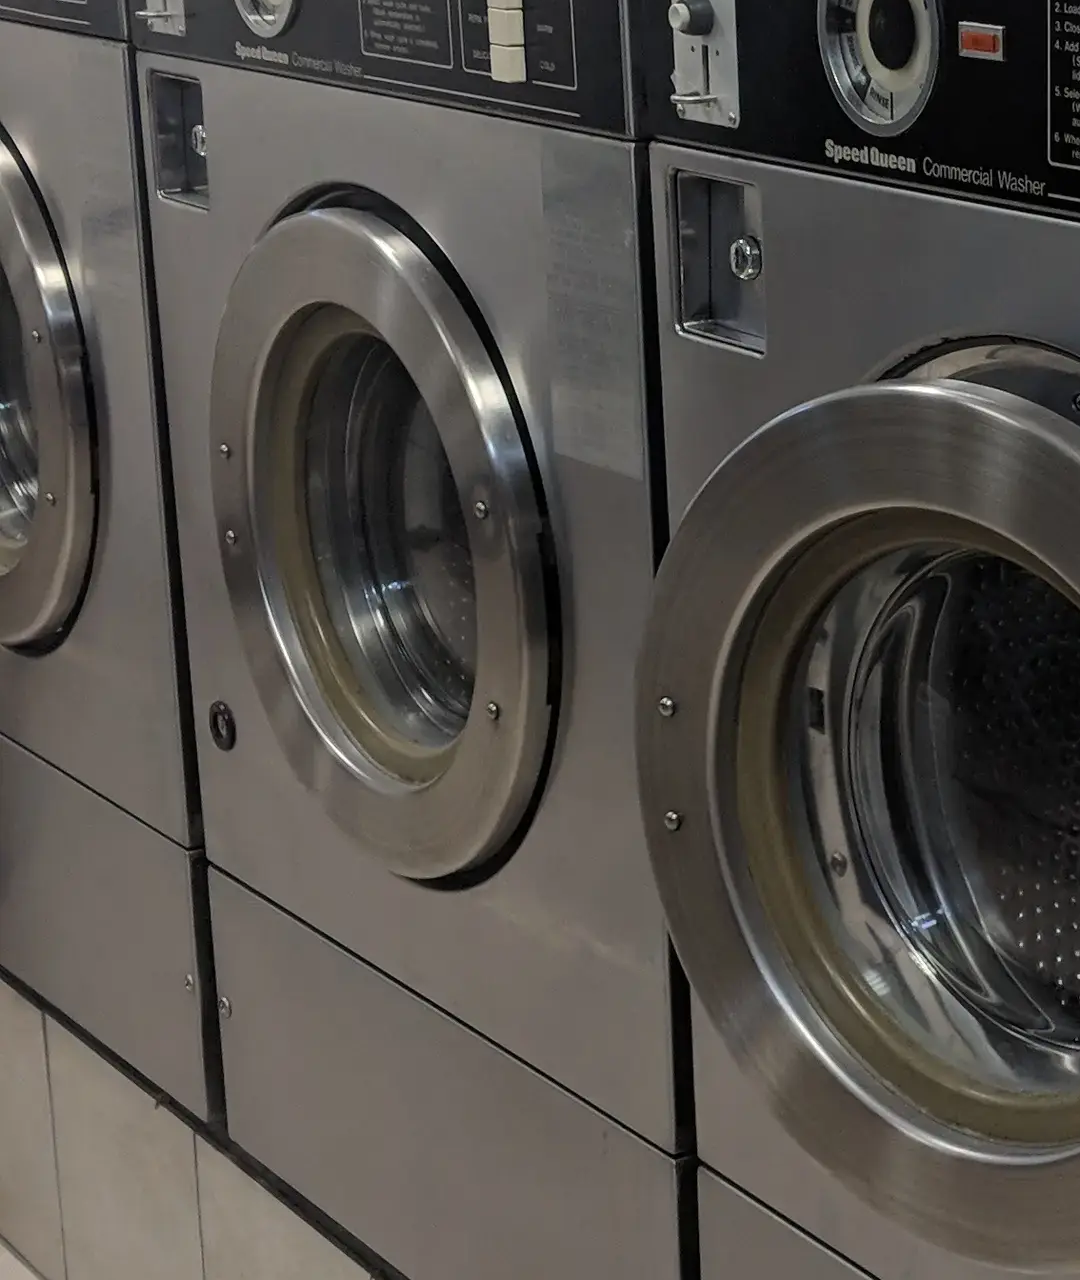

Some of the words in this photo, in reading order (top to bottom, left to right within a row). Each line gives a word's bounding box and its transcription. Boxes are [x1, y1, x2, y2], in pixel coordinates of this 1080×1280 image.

[1064, 40, 1079, 53] Add
[1072, 70, 1080, 81] lid
[869, 86, 890, 110] RINSE
[825, 138, 869, 164] Speed
[870, 146, 916, 173] Queen
[922, 156, 993, 187] Commercial
[997, 170, 1046, 197] Washer
